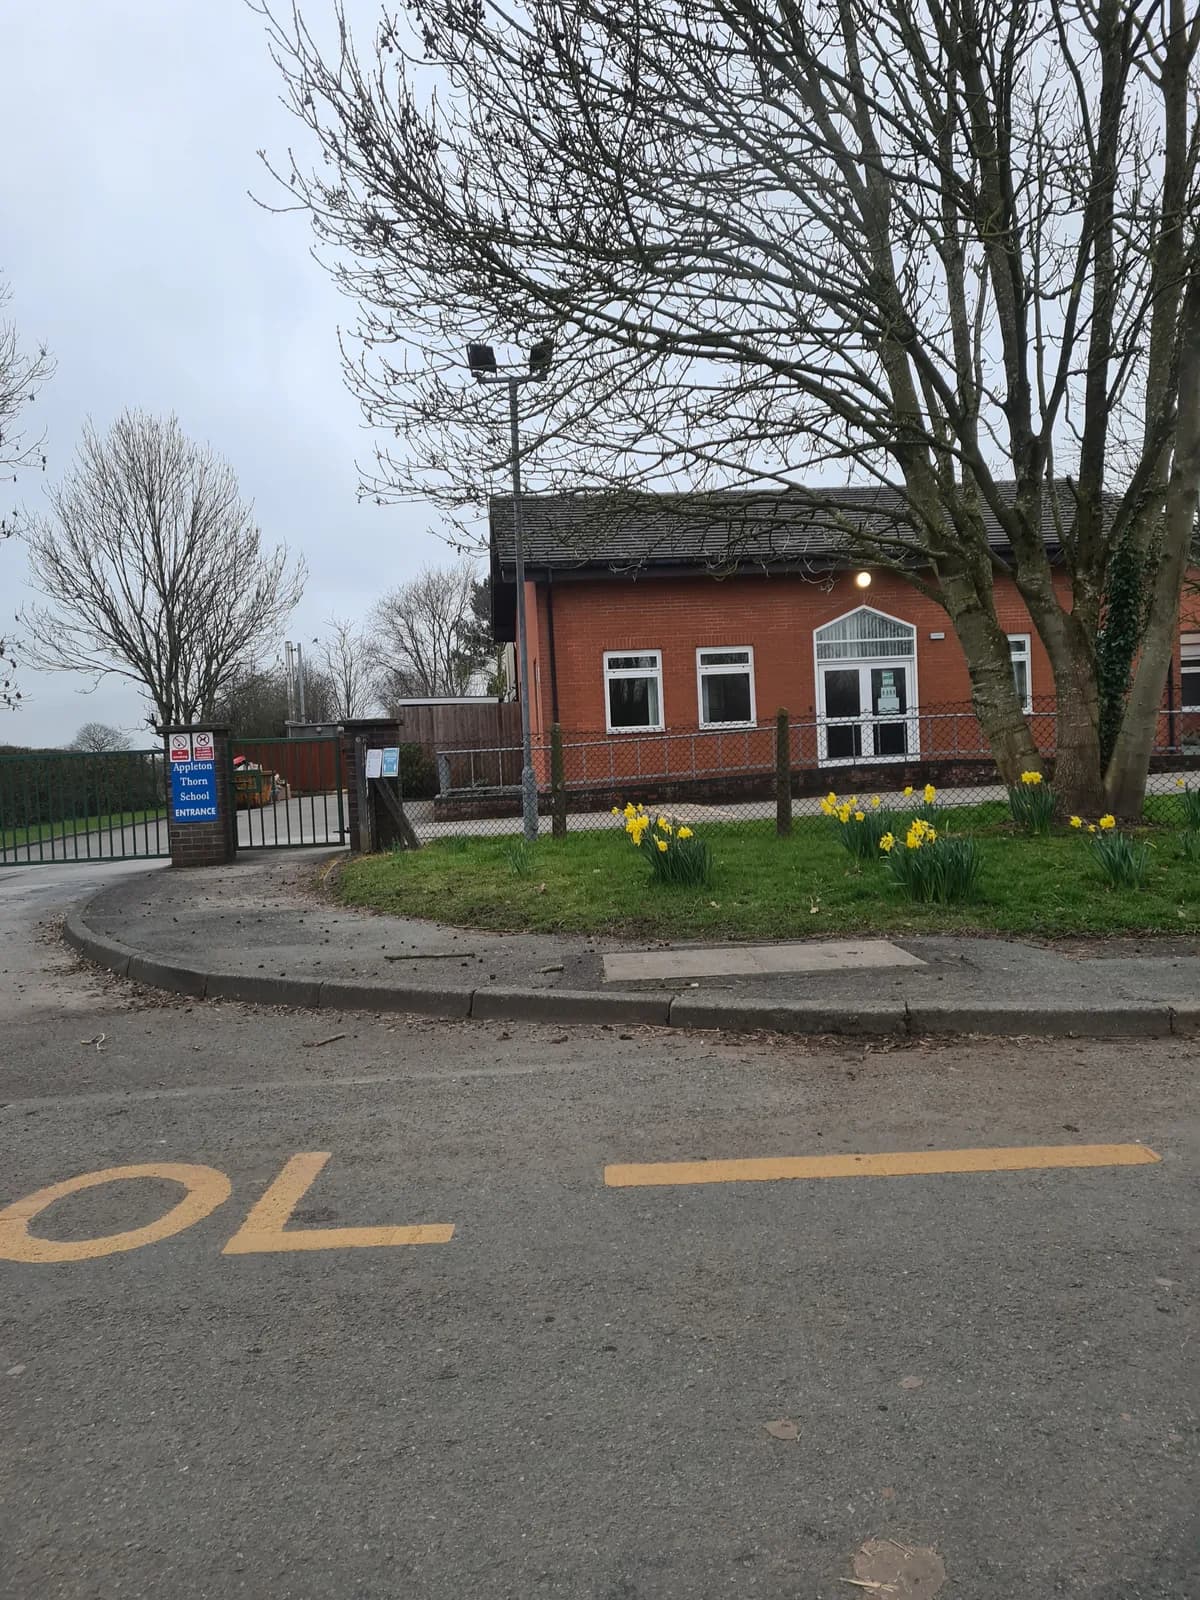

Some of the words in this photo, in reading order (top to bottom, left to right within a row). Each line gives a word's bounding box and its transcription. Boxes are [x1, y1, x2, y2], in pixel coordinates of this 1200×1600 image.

[173, 763, 212, 773] Appleton
[180, 777, 208, 786] Thorn
[180, 792, 209, 801] School
[175, 808, 216, 816] ENTRANCE
